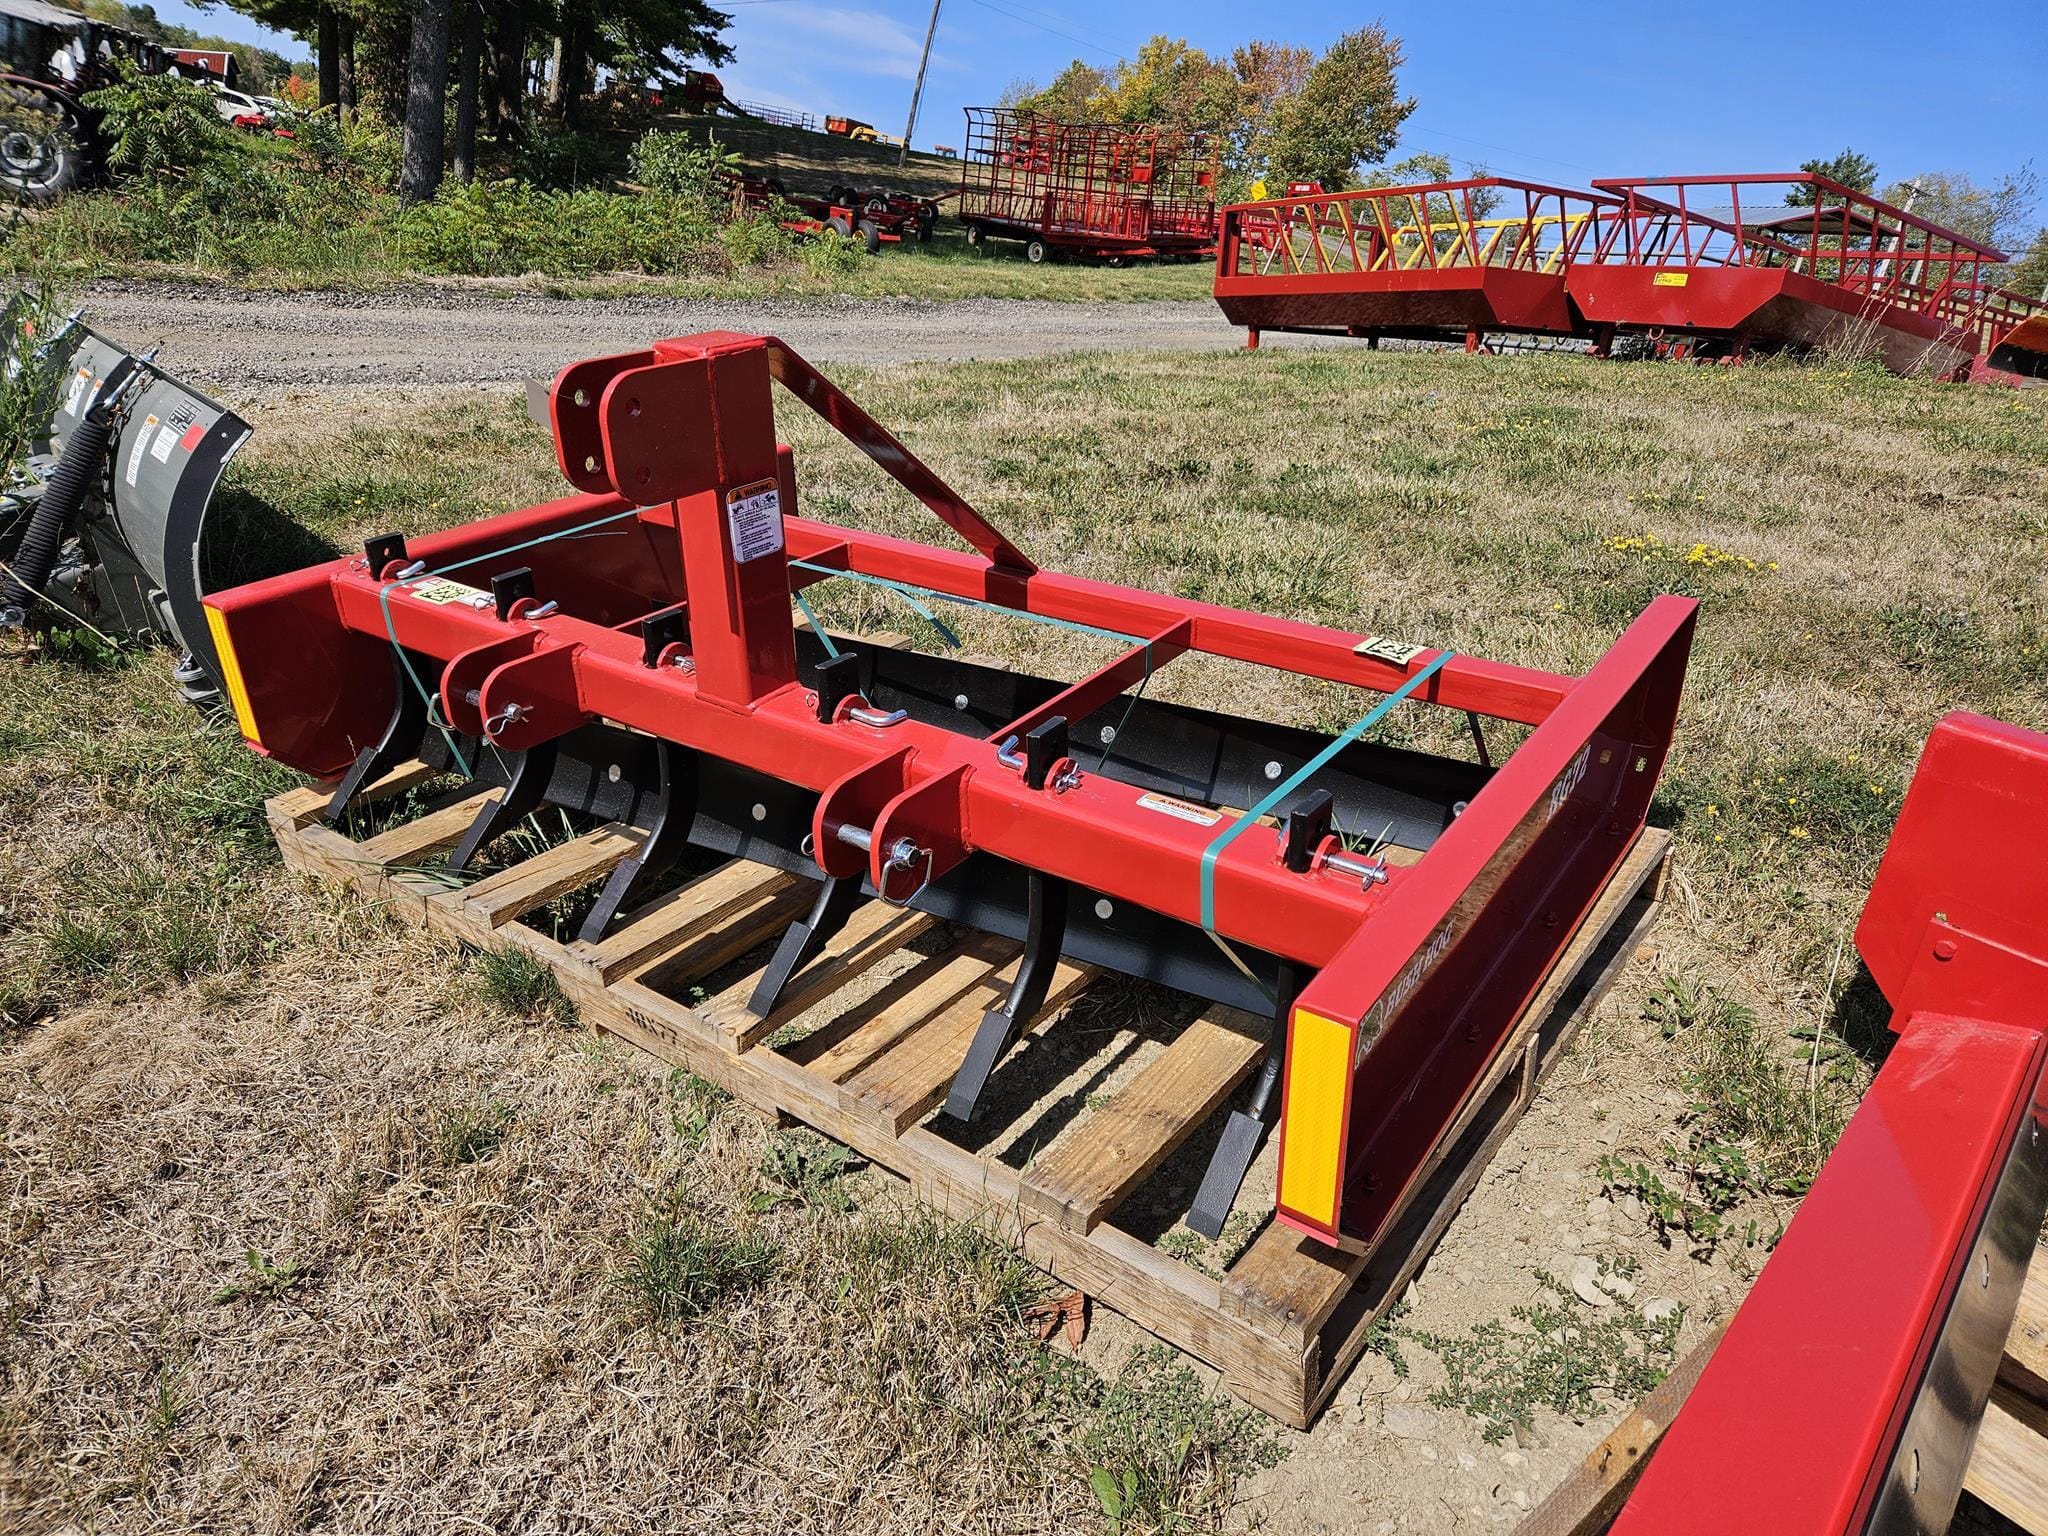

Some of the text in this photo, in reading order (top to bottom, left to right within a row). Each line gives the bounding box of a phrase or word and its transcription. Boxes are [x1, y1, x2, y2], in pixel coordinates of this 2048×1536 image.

[1168, 801, 1206, 815] WARNING
[1384, 916, 1457, 1021] BUSH HOG
